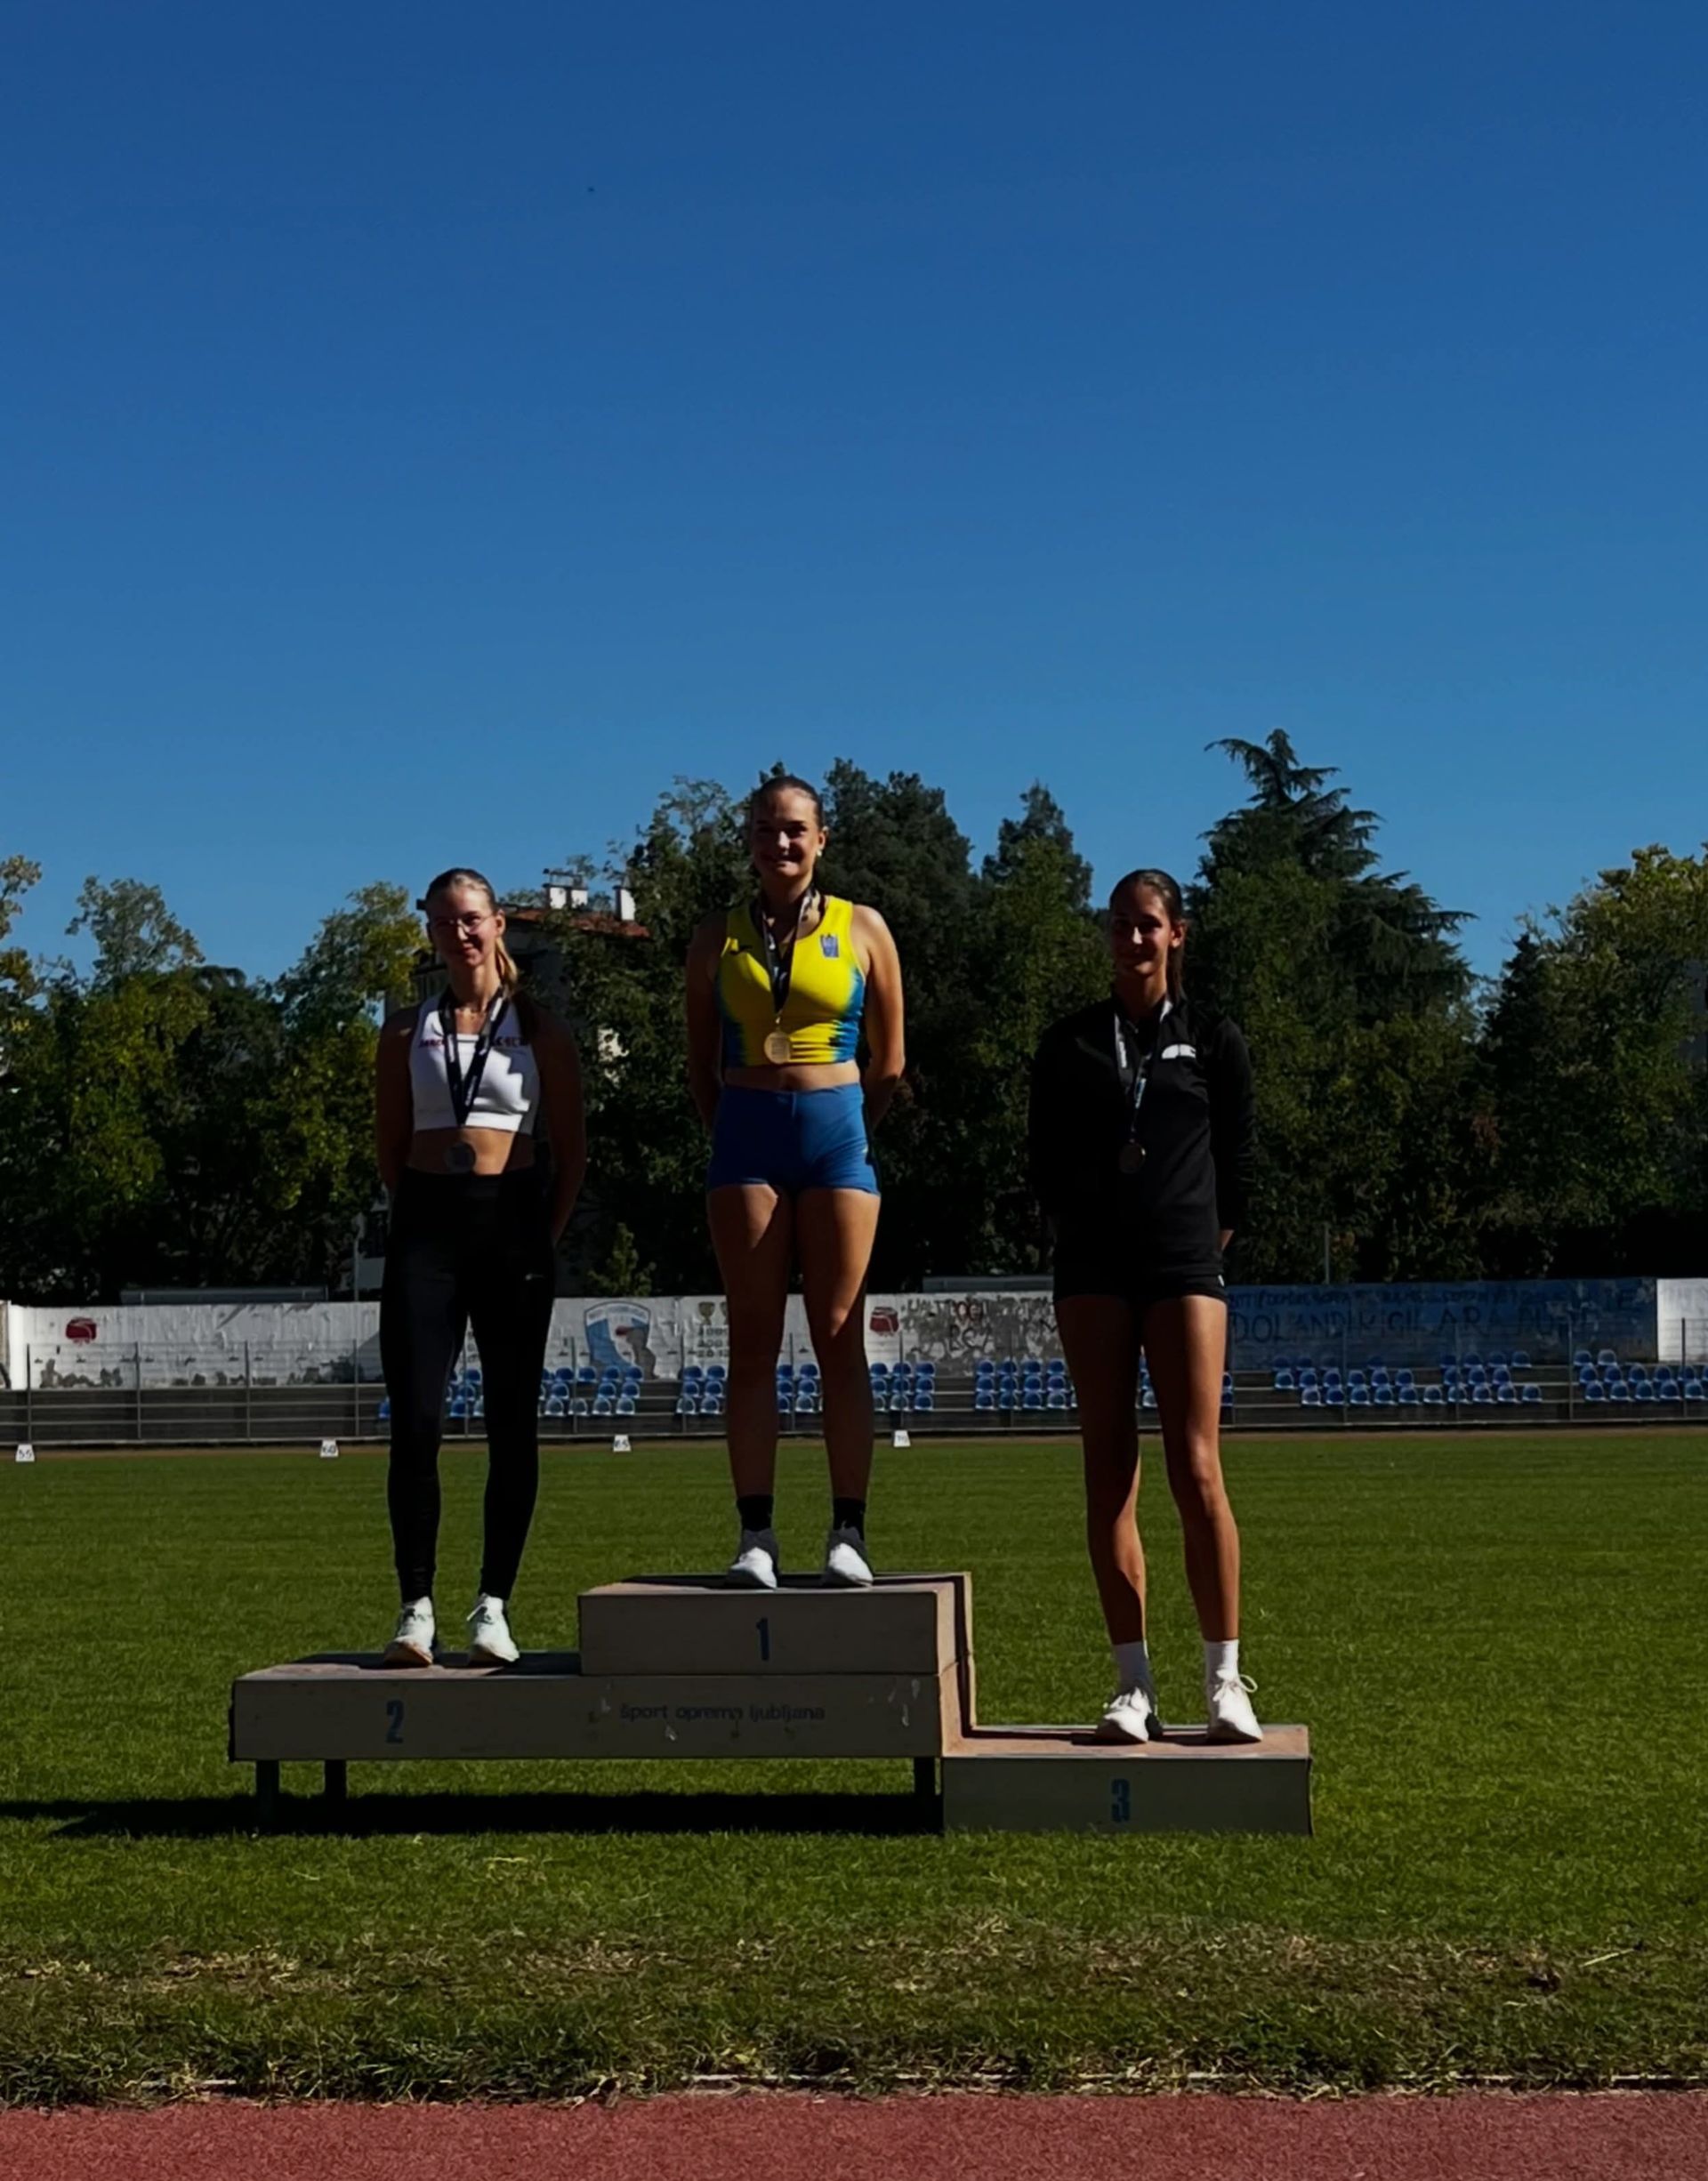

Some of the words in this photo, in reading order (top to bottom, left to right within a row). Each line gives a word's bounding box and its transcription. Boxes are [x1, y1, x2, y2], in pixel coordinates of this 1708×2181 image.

[756, 1617, 769, 1662] 1
[386, 1700, 404, 1743] 2
[749, 1703, 826, 1723] ljubljana
[1111, 1778, 1131, 1823] 3
